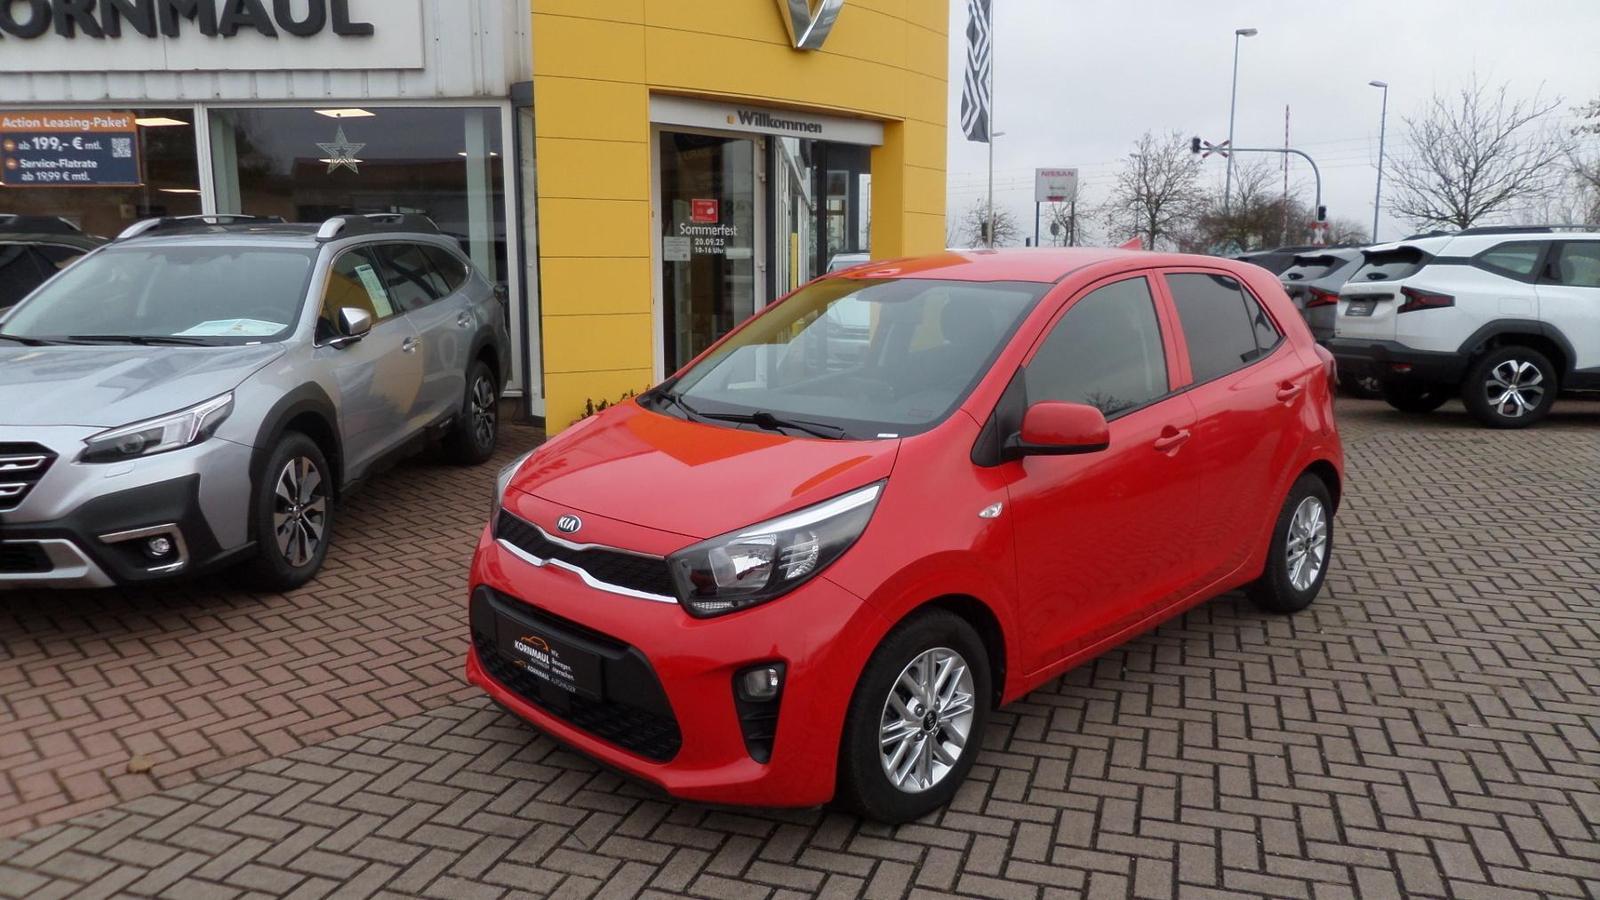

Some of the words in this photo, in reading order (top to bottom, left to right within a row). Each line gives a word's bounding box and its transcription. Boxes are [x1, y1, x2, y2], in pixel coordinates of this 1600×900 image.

[0, 0, 374, 39] ORNMAUL
[2, 117, 40, 128] Action
[738, 110, 822, 133] Willkommen
[18, 141, 31, 150] ab
[72, 137, 83, 150] €
[85, 141, 102, 150] mtl.
[20, 159, 98, 168] Service-Flatrate
[22, 172, 34, 180] ab
[63, 172, 70, 180] €
[72, 172, 91, 180] mtl.
[680, 223, 737, 236] Sommerfest
[695, 238, 724, 246] 20.09.25
[558, 517, 575, 530] KIA
[514, 640, 550, 664] KORNMAUL
